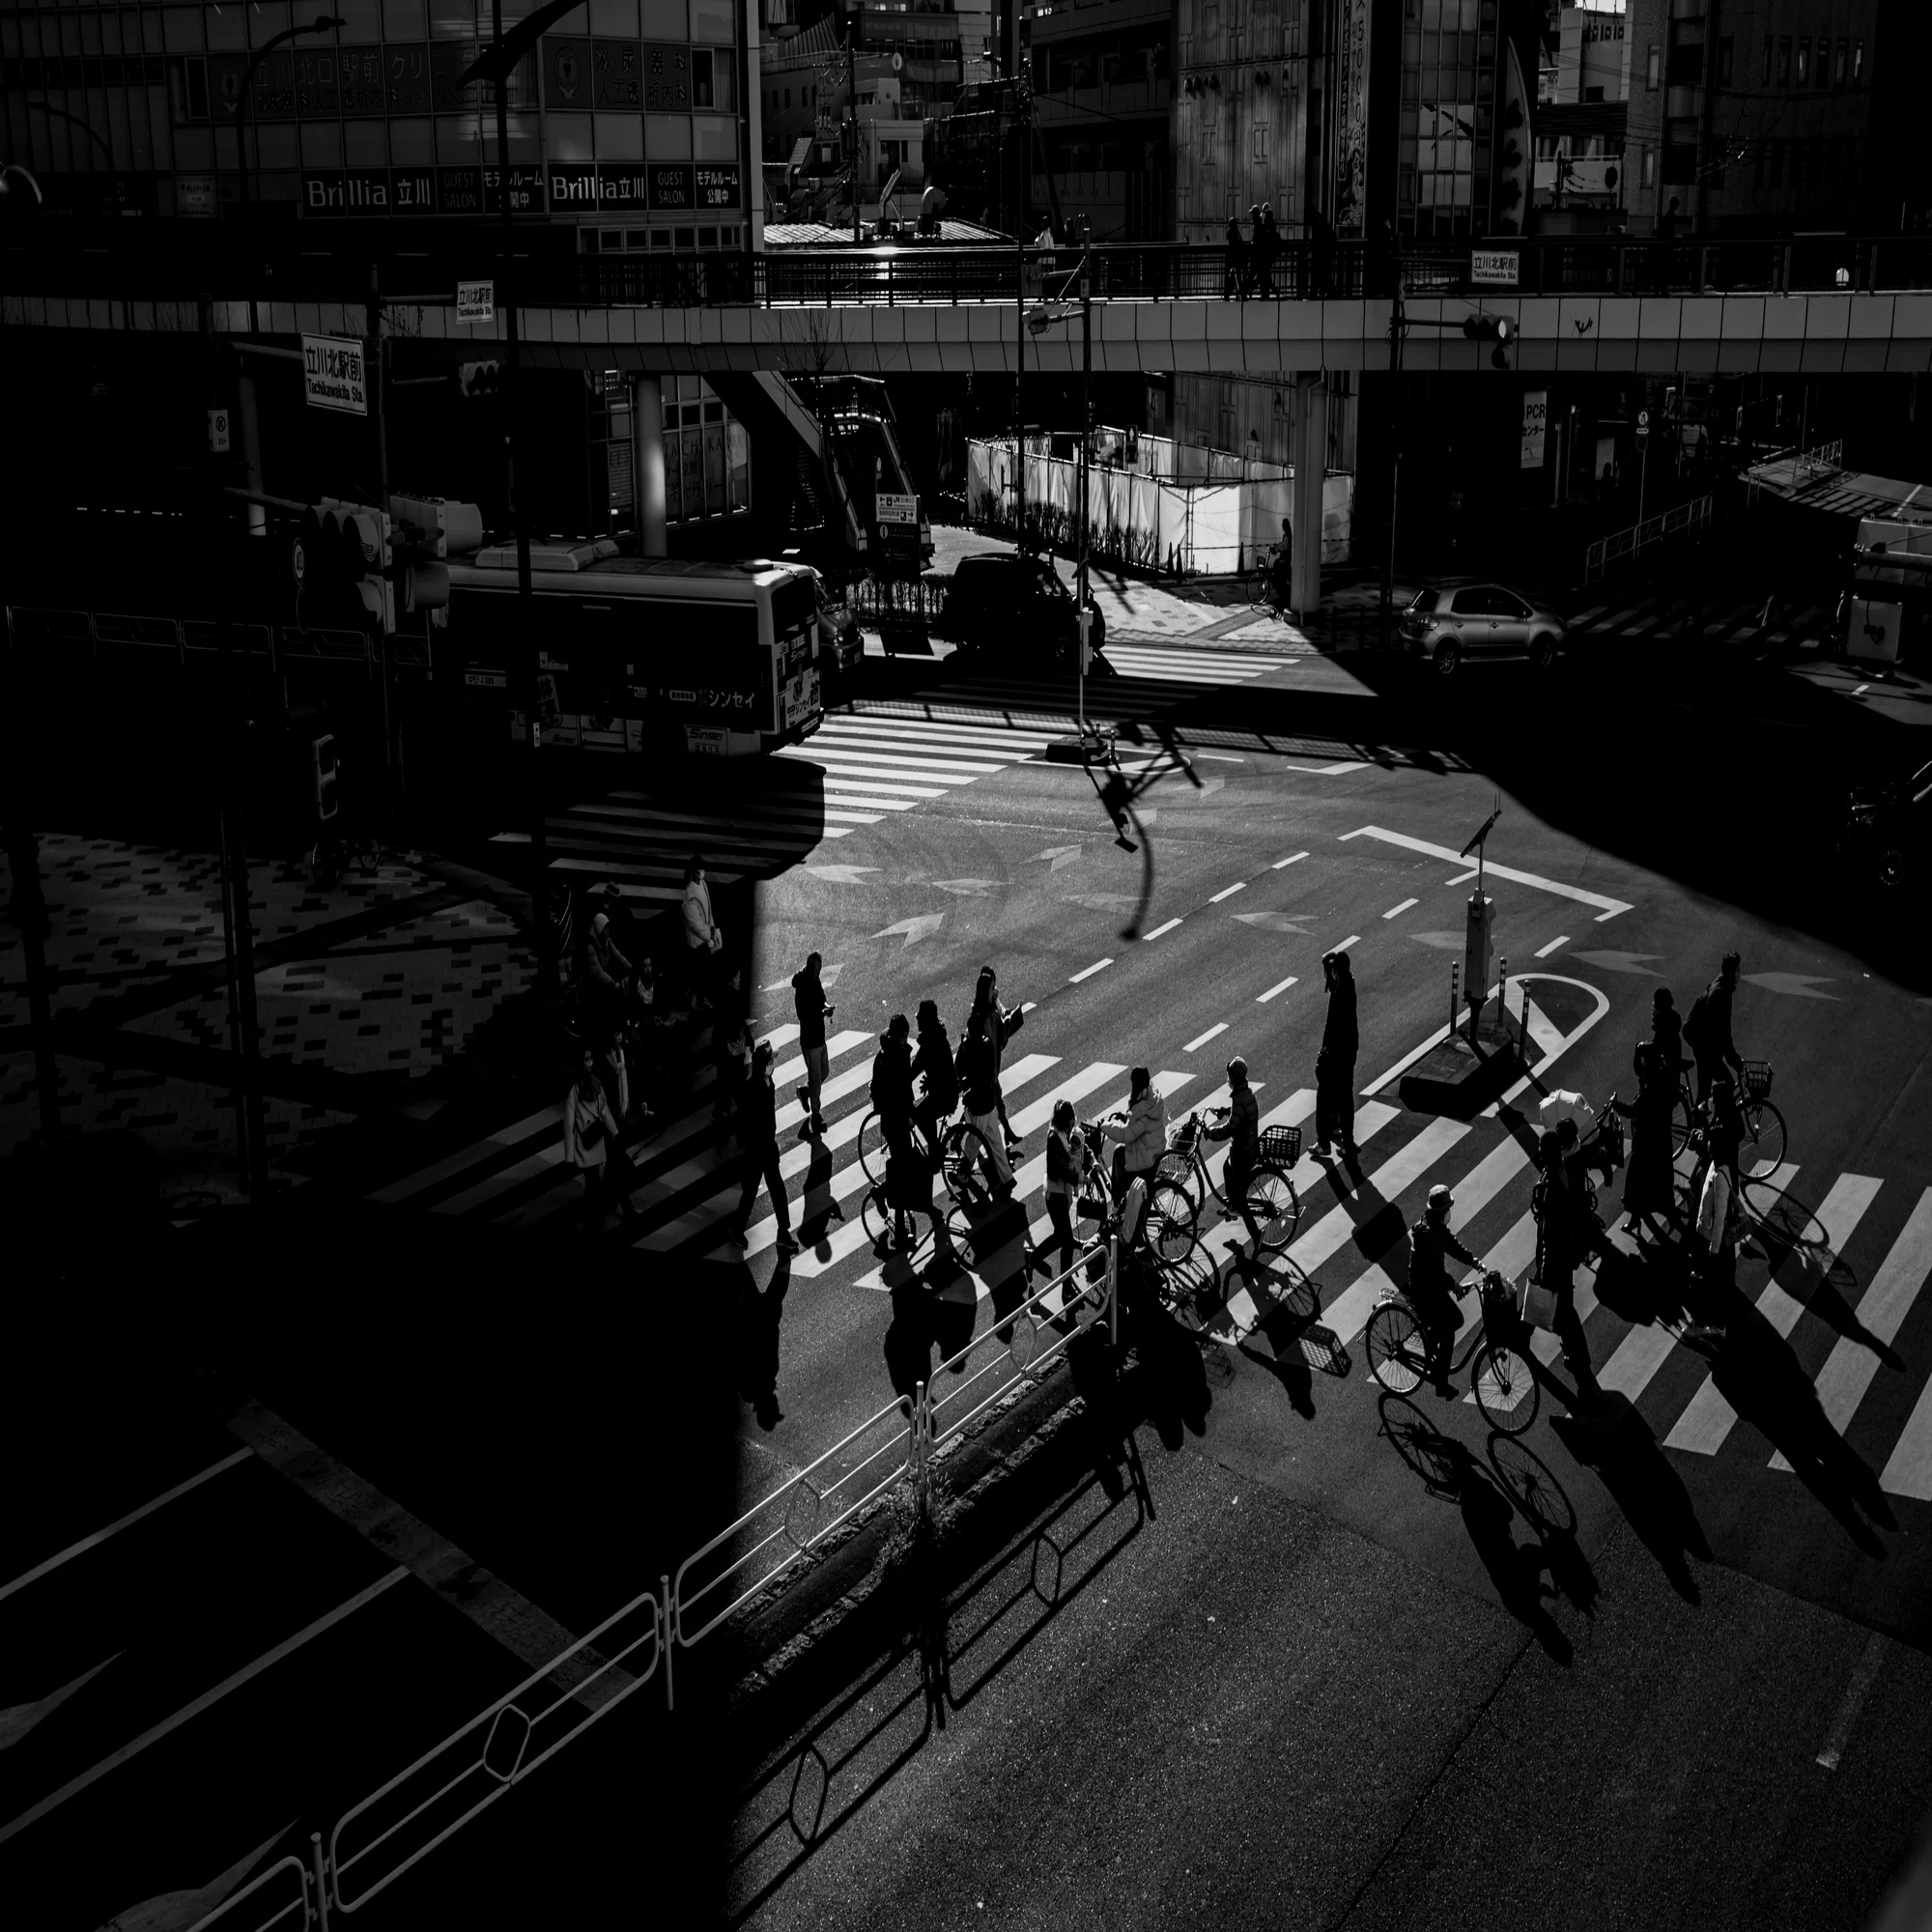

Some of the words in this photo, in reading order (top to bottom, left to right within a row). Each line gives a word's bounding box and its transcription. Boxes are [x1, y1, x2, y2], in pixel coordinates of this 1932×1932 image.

[443, 172, 476, 188] GUEST
[658, 171, 684, 185] GUEST
[696, 170, 738, 185] モデルルーム
[308, 178, 388, 207] Brillia
[397, 177, 436, 206] 立川
[552, 176, 618, 200] Brillia
[619, 176, 645, 199] 立川
[707, 188, 729, 204] 公開中
[444, 193, 476, 209] SALON
[658, 189, 685, 204] SALON
[1474, 256, 1517, 270] 立川北駅前
[459, 287, 492, 305] 立川北駅前
[305, 346, 362, 383] 立川北駅前
[308, 378, 350, 400] Tachikawakita
[1526, 403, 1546, 419] PCR
[709, 689, 755, 709] シンセイ
